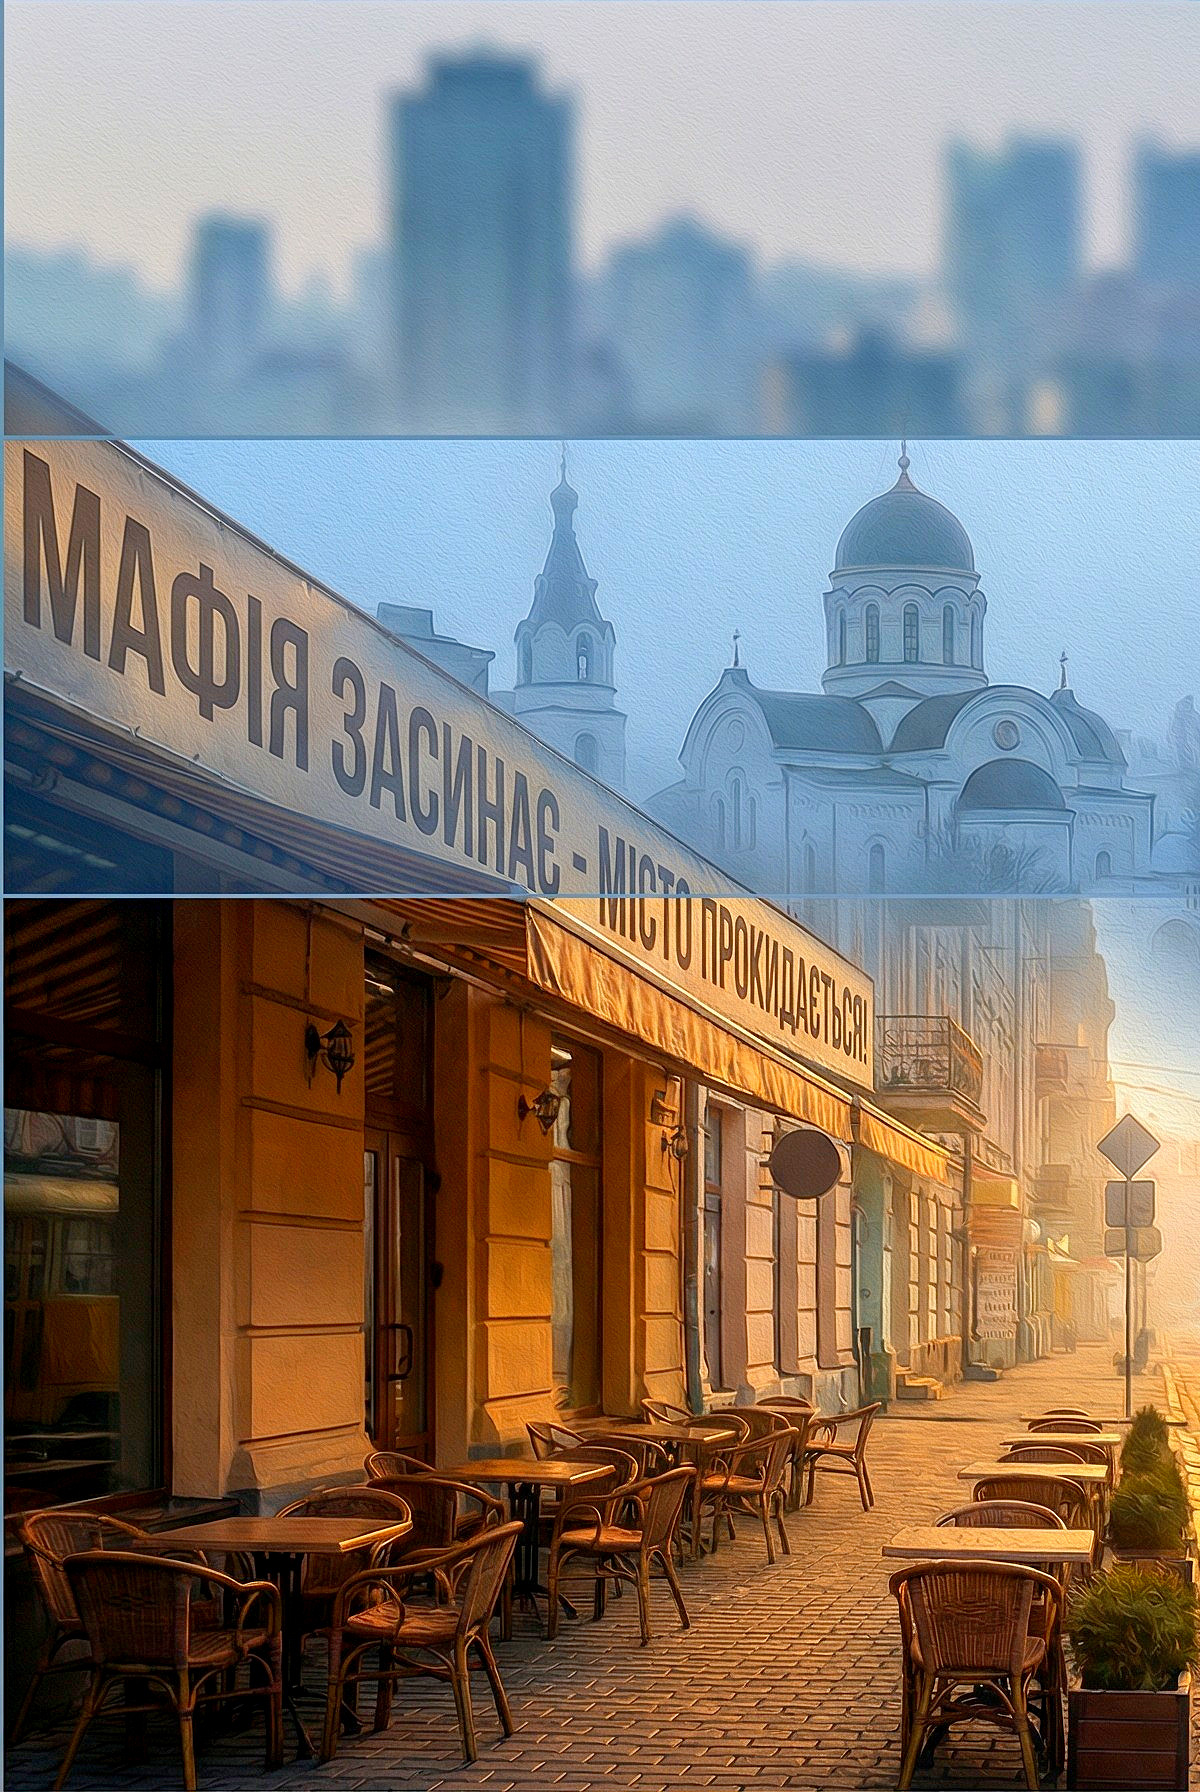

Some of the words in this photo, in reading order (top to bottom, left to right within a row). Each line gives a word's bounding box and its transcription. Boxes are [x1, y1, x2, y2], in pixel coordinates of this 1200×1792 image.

[22, 448, 310, 773] МАФІЯ
[331, 656, 562, 901] ЗАСИНАЄ
[572, 851, 588, 875] -
[598, 824, 693, 971] МІСТО
[700, 896, 869, 1066] ПРОКИДАЄТЬСЯ!
